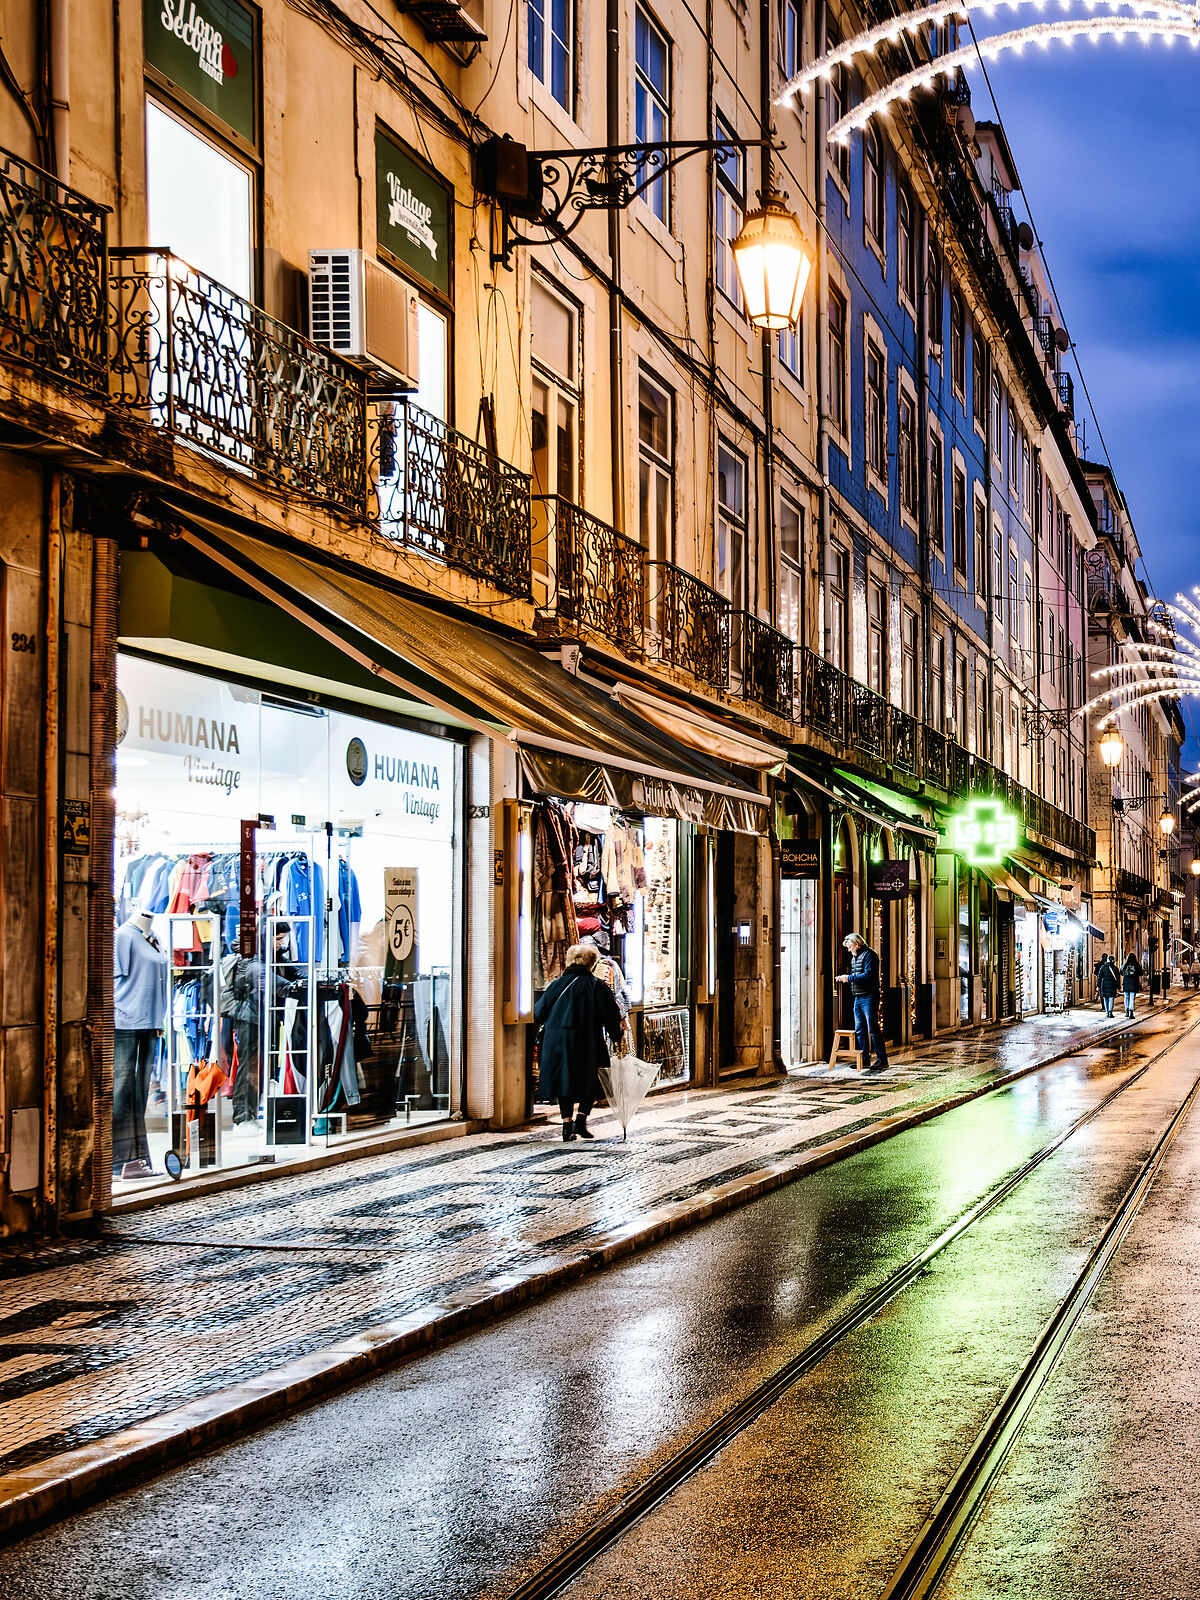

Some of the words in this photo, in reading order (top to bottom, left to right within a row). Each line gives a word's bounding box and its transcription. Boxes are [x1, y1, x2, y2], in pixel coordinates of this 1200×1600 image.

[161, 0, 224, 73] Second
[386, 171, 432, 225] Vintage
[12, 632, 36, 655] 234
[139, 705, 241, 755] HUMANA
[183, 754, 241, 796] Vintage
[374, 753, 440, 791] HUMANA
[402, 791, 440, 824] Vintage
[469, 805, 490, 819] 230
[983, 823, 1010, 843] 19
[393, 919, 410, 949] 5€
